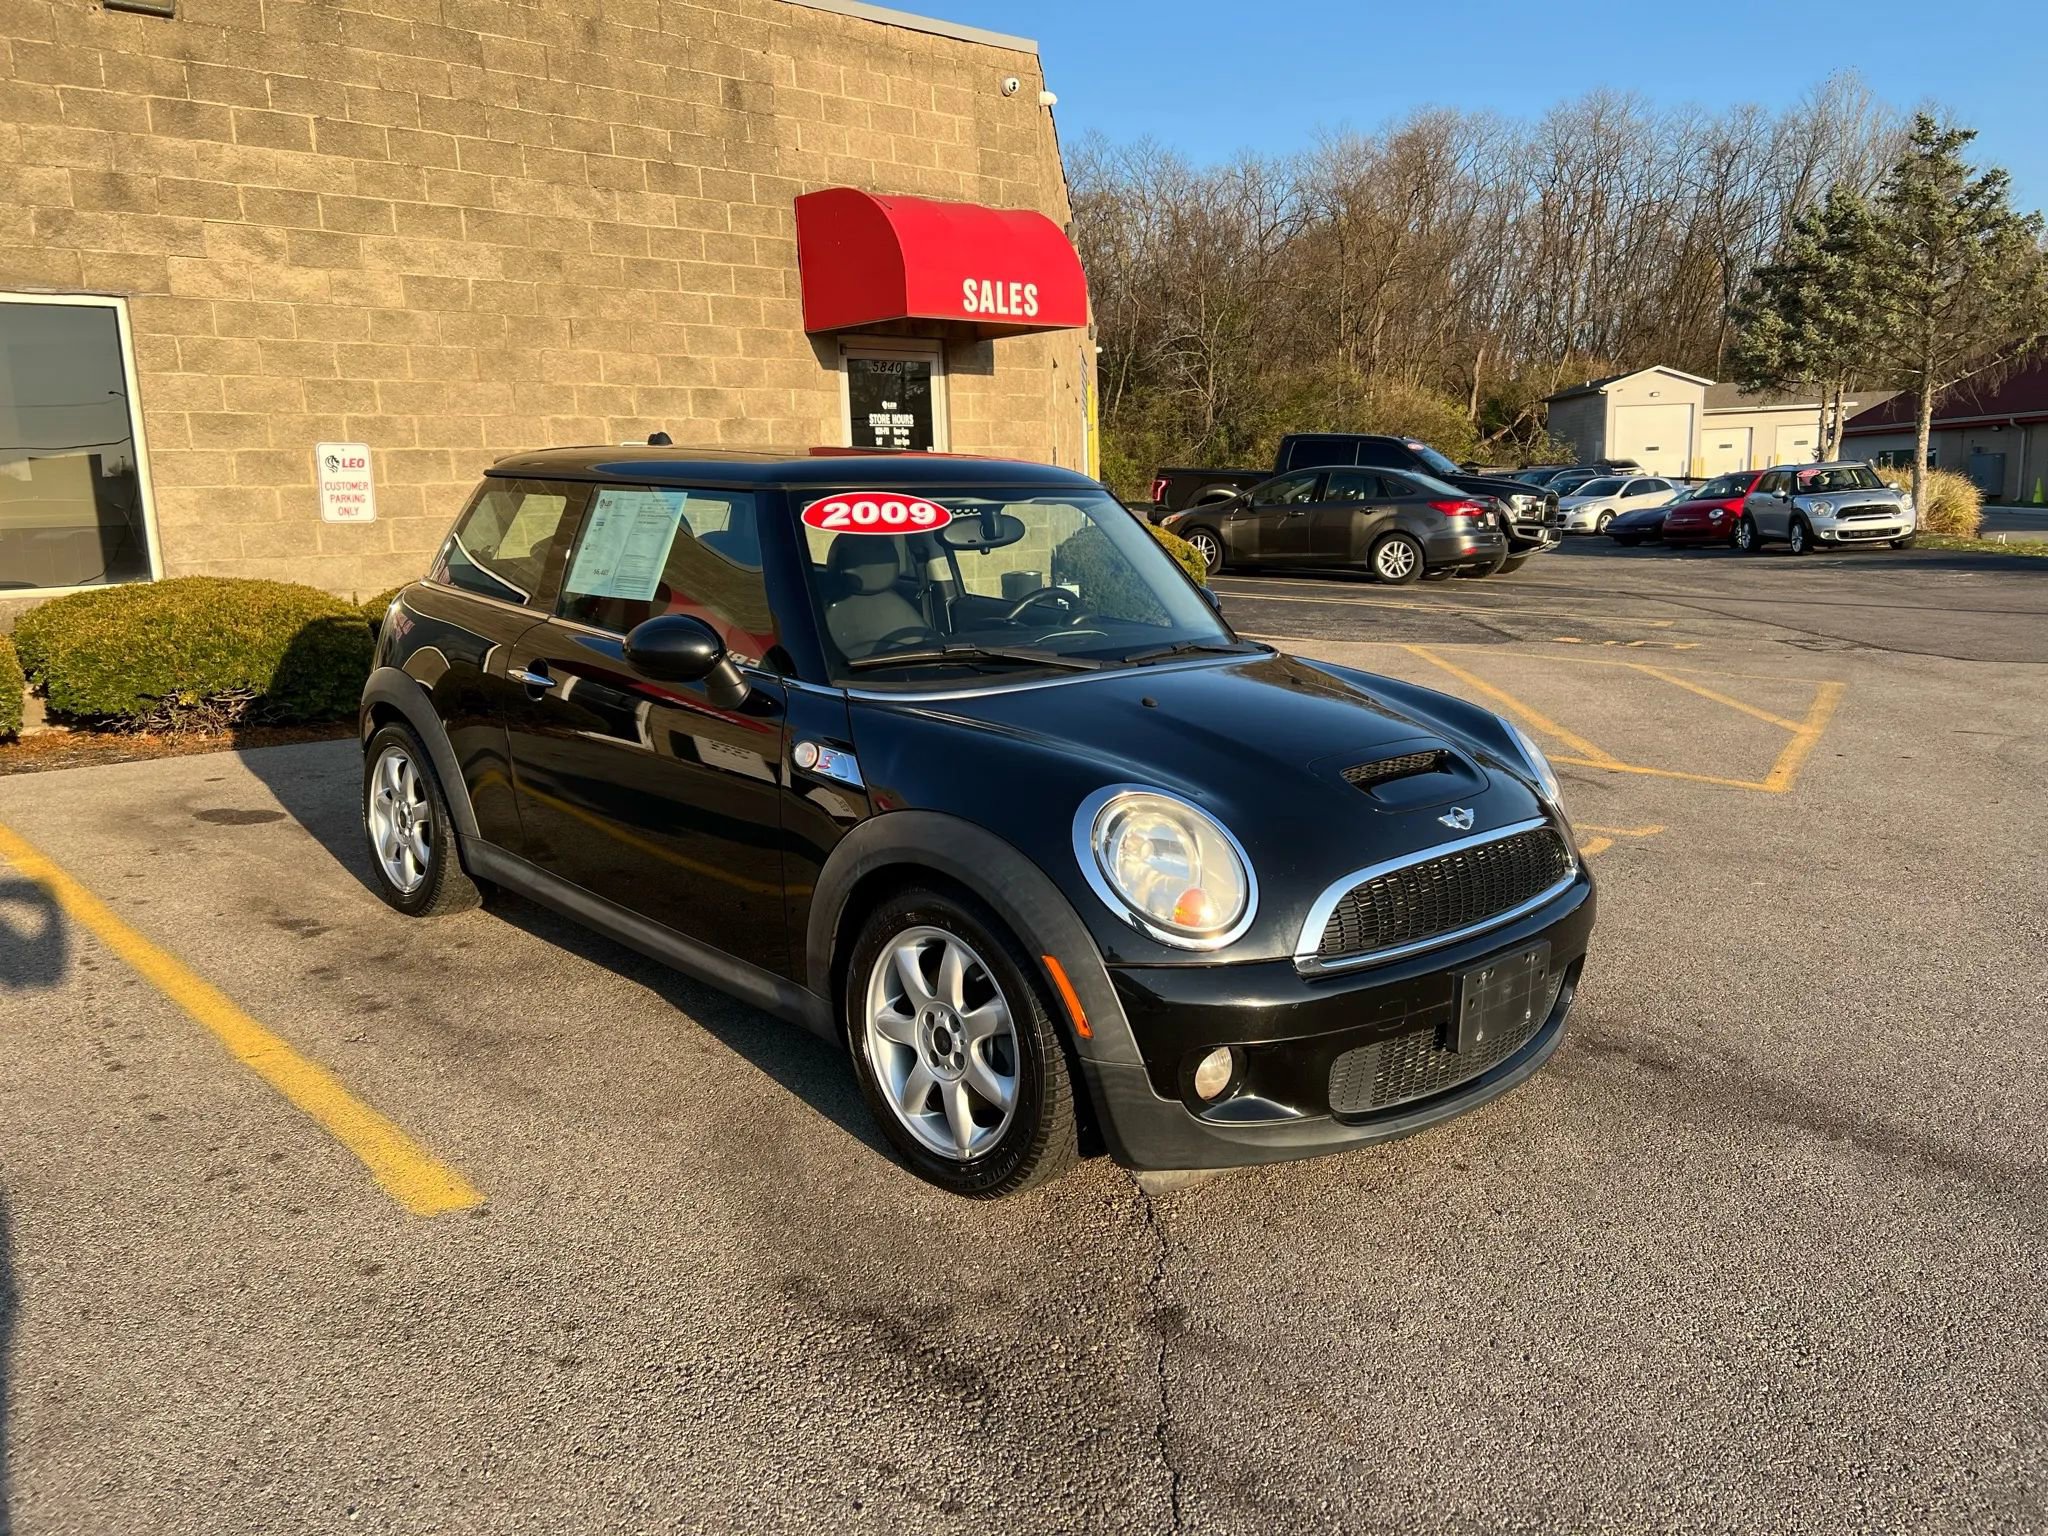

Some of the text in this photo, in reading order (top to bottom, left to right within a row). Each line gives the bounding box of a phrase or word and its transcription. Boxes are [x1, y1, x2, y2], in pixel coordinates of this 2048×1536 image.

[962, 278, 1039, 317] SALES
[872, 361, 902, 374] 5840
[869, 414, 914, 425] STORE HOURS
[341, 458, 365, 468] LEO
[324, 482, 369, 491] CUSTOMER
[329, 494, 366, 503] PARKING
[337, 507, 359, 516] ONLY
[820, 501, 937, 527] 2009
